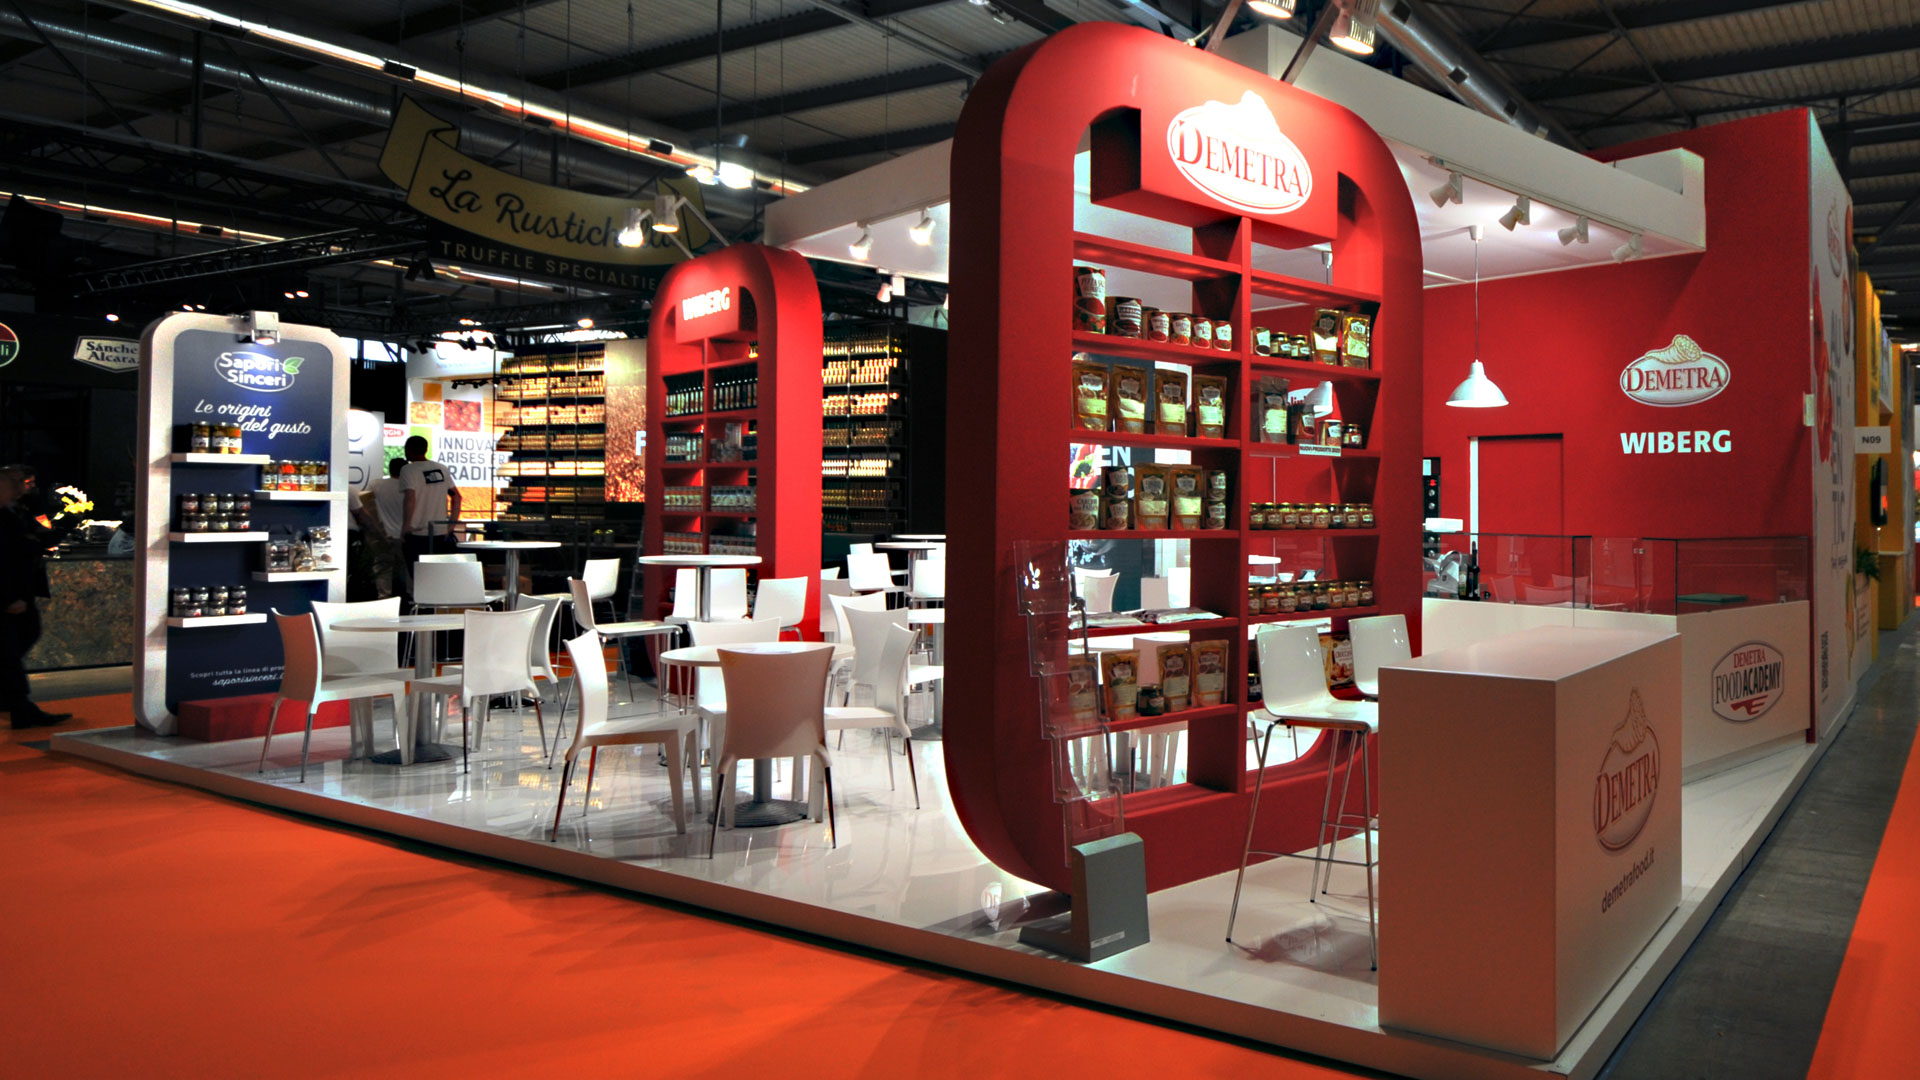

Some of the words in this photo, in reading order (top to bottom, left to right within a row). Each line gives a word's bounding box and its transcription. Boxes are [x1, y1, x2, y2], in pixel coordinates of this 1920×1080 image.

[1176, 119, 1305, 198] DEMETRA
[429, 168, 483, 214] La
[495, 192, 681, 249] Rustichlla
[440, 239, 535, 271] TRUFFLE
[545, 258, 657, 291] SPECIALTIE
[681, 286, 731, 321] WIBERG
[86, 340, 138, 354] Sánche
[88, 351, 139, 364] Alcara
[218, 352, 281, 373] Sapori
[227, 369, 287, 387] Sinceri
[1625, 366, 1724, 393] DEMETRA
[194, 399, 215, 414] Le
[217, 403, 272, 422] origini
[240, 418, 268, 432] del
[270, 421, 312, 440] gusto
[1861, 435, 1882, 444] N09
[1619, 429, 1732, 455] WIBERG
[437, 451, 486, 464] ARISES
[1733, 648, 1767, 669] DEMETRA
[190, 671, 214, 679] Scopri
[212, 672, 285, 688] saporisinceri.i
[1597, 749, 1658, 835] DEMETRA
[1601, 847, 1656, 914] demetrafood.it
